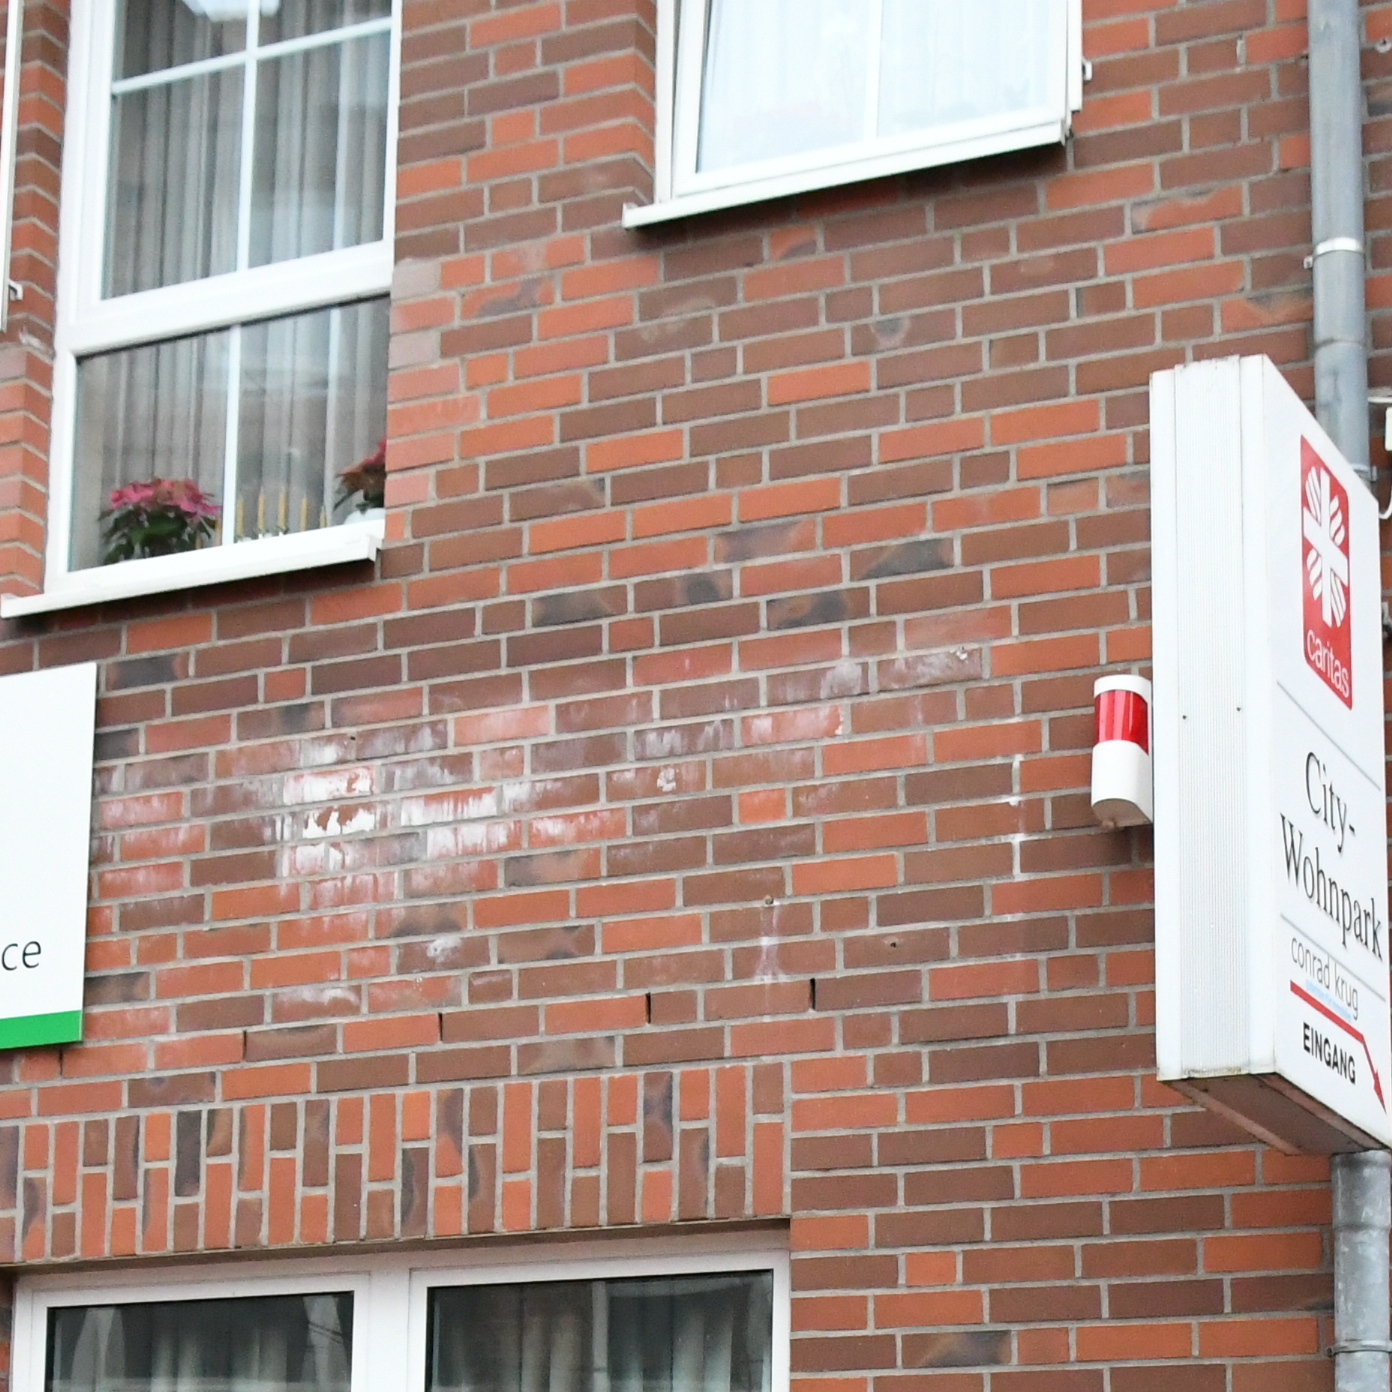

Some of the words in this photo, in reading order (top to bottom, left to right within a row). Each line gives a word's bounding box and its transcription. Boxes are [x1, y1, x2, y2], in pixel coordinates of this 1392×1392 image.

[1306, 627, 1350, 699] caritas
[1304, 751, 1356, 854] City-
[1279, 813, 1383, 962] Wohnpark
[1291, 937, 1330, 990] conrad
[1334, 962, 1359, 1021] krug
[1303, 1021, 1356, 1085] EINGANG
